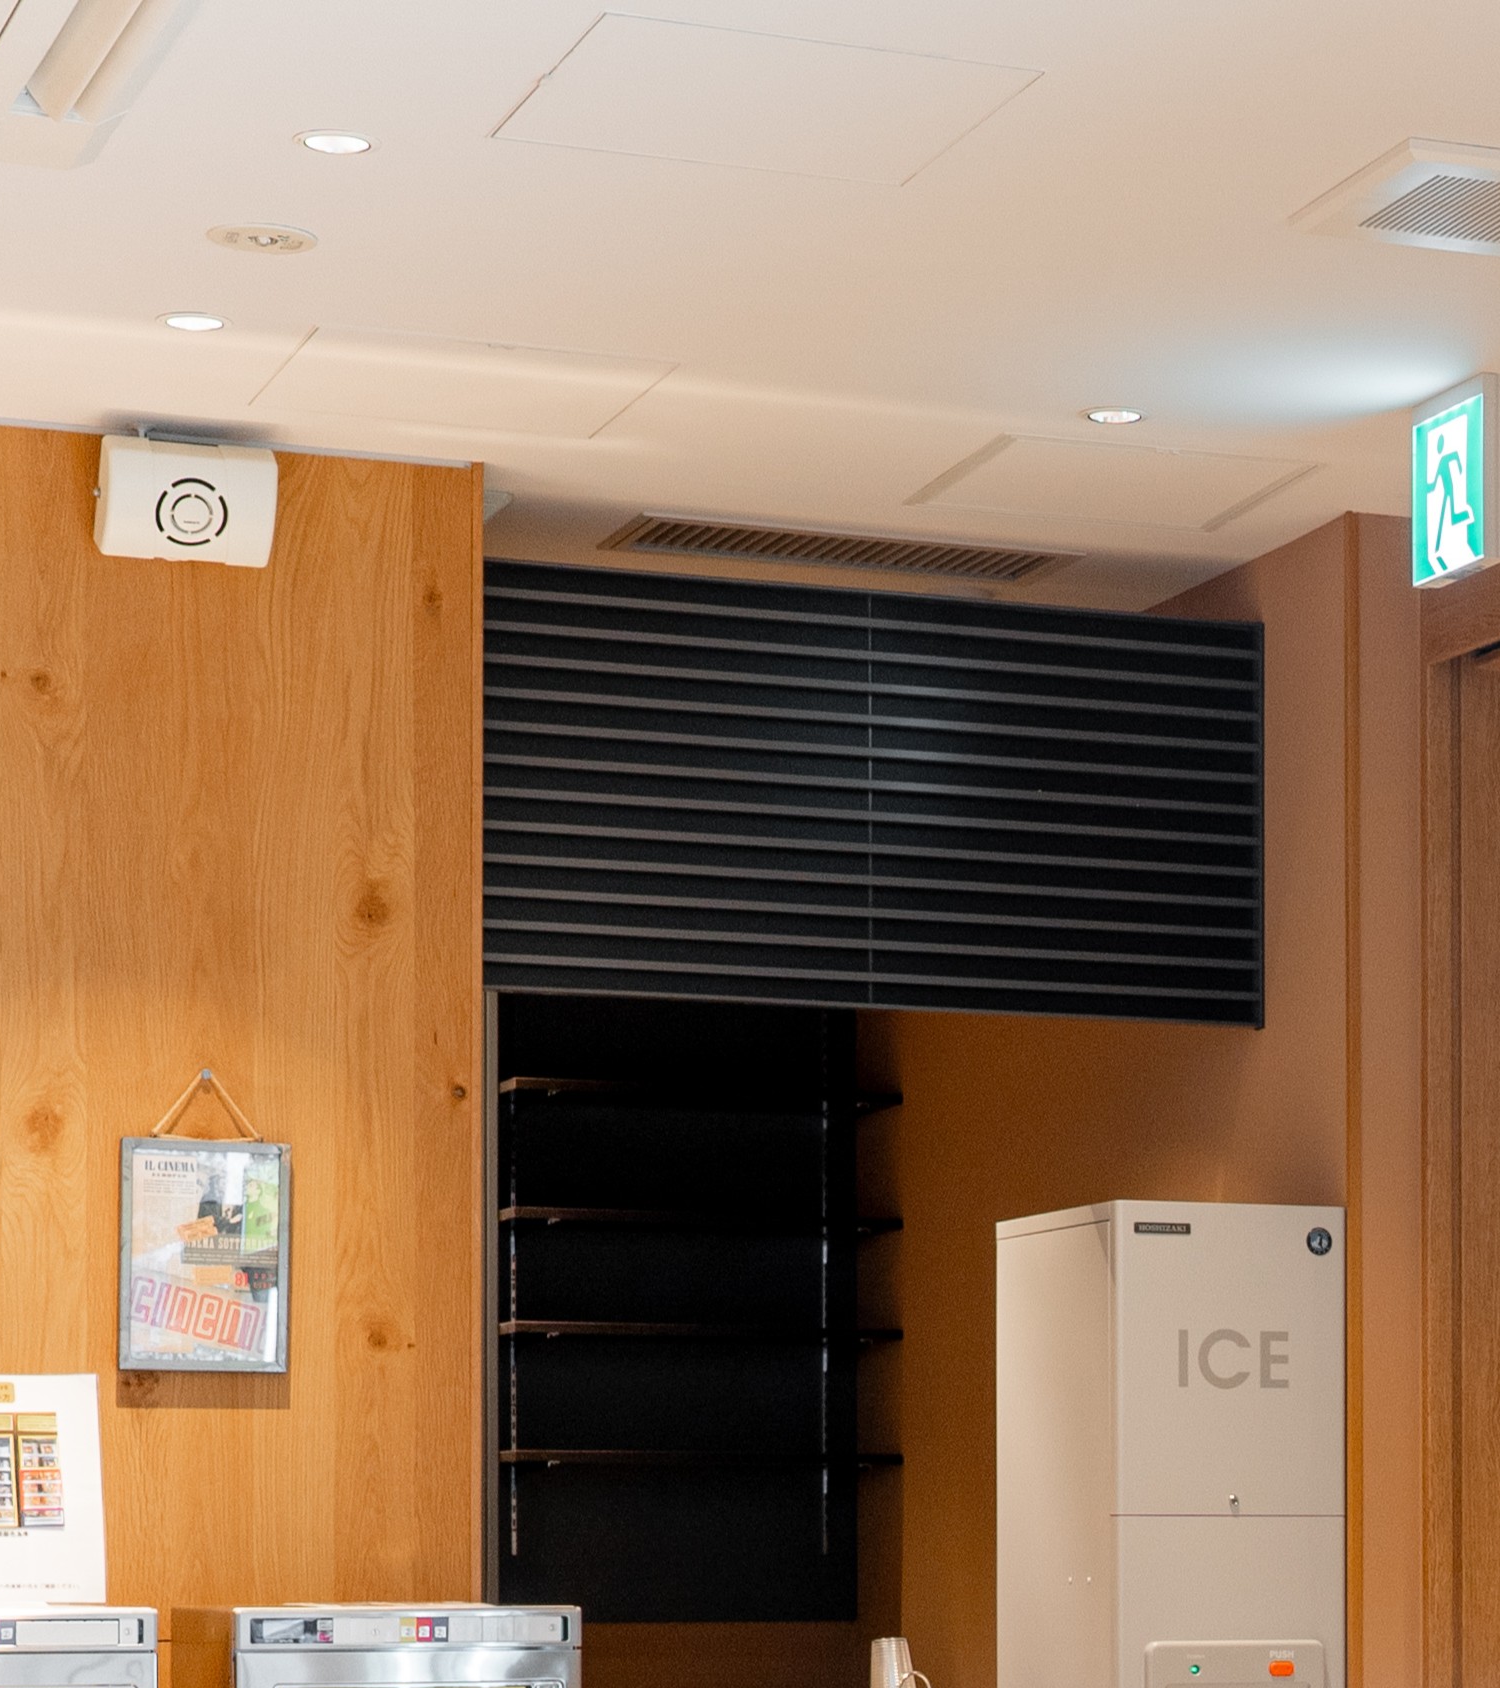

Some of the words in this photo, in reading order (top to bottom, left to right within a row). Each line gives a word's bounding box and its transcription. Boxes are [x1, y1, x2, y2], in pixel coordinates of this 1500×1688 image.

[144, 1160, 155, 1171] IL
[158, 1160, 195, 1173] CINEMA
[1138, 1224, 1188, 1233] HOSHIZAKI
[1178, 1328, 1290, 1390] ICE
